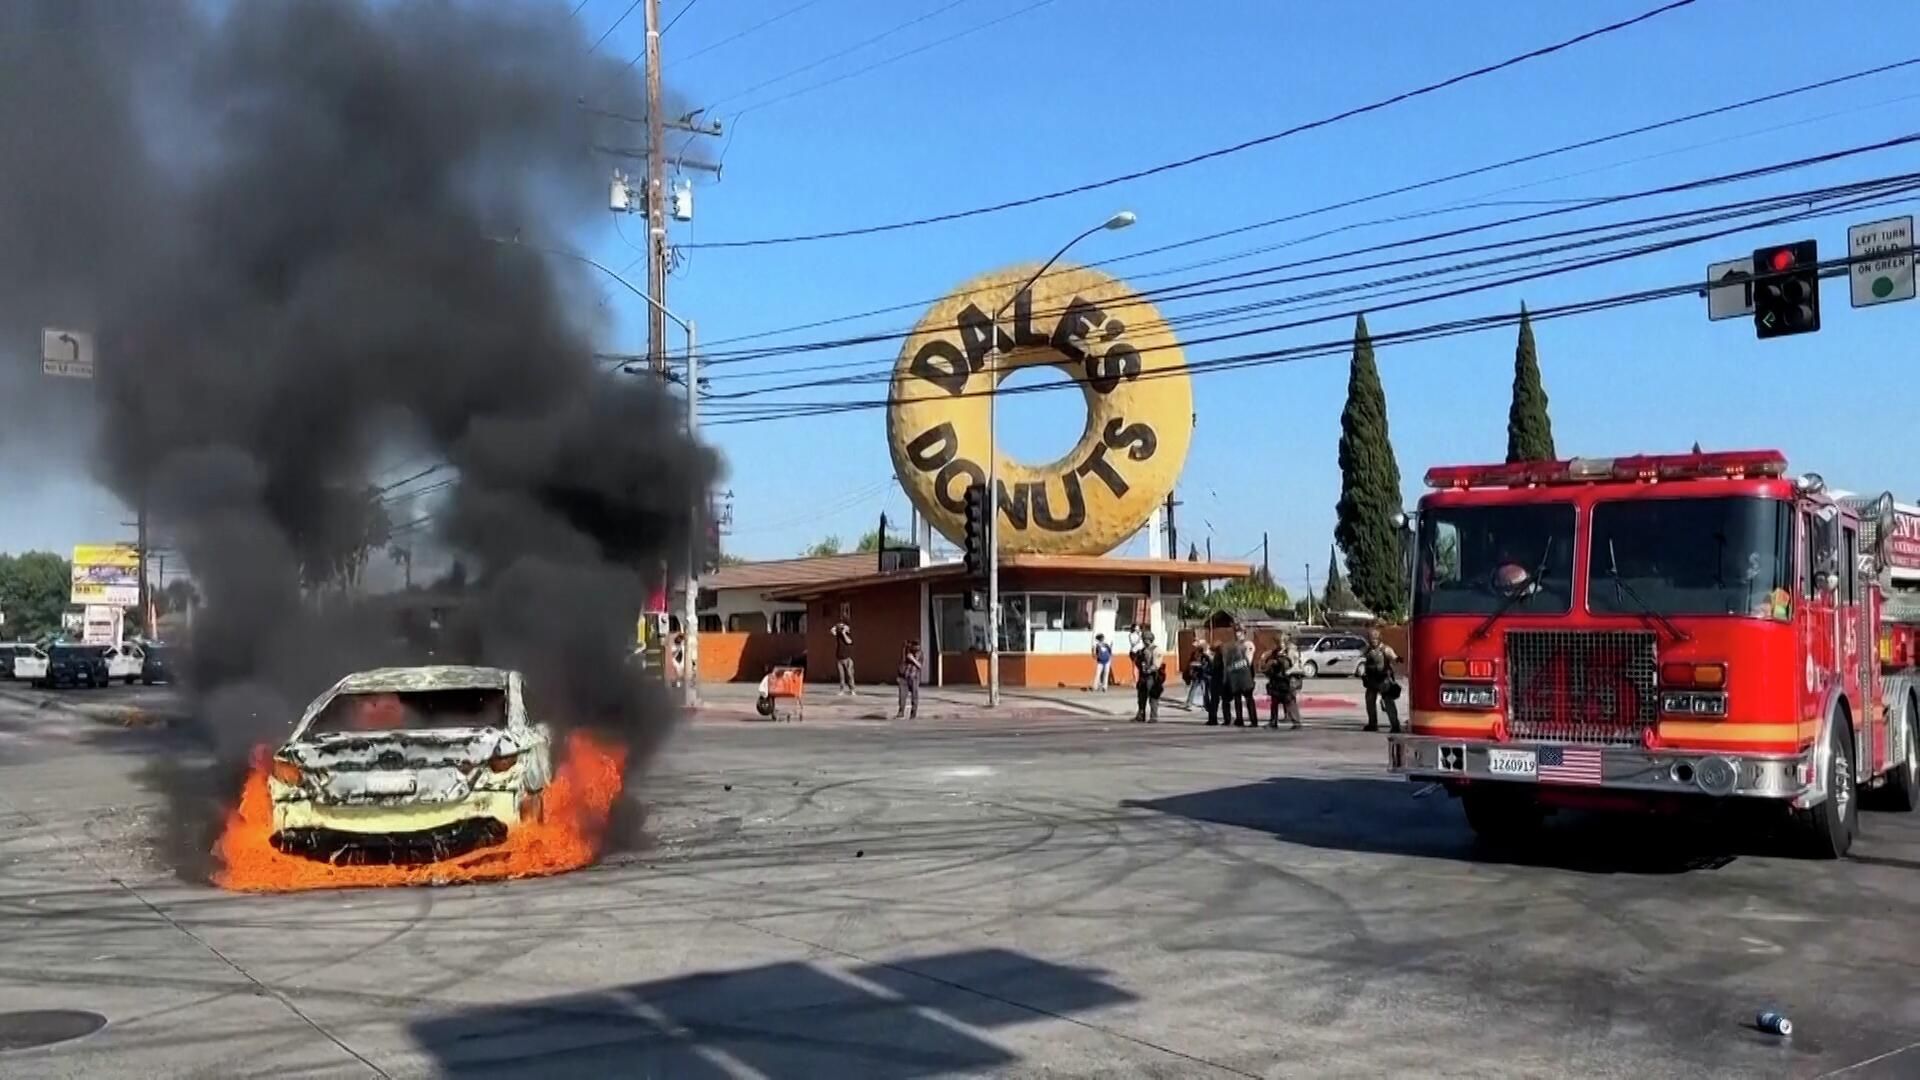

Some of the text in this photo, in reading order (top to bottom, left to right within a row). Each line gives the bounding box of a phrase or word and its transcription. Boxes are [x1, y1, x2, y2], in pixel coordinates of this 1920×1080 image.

[1856, 228, 1905, 245] LEFT TURN
[1858, 258, 1905, 274] ON GREEN
[905, 417, 1157, 532] DONUTS
[1493, 759, 1536, 772] 1260919
